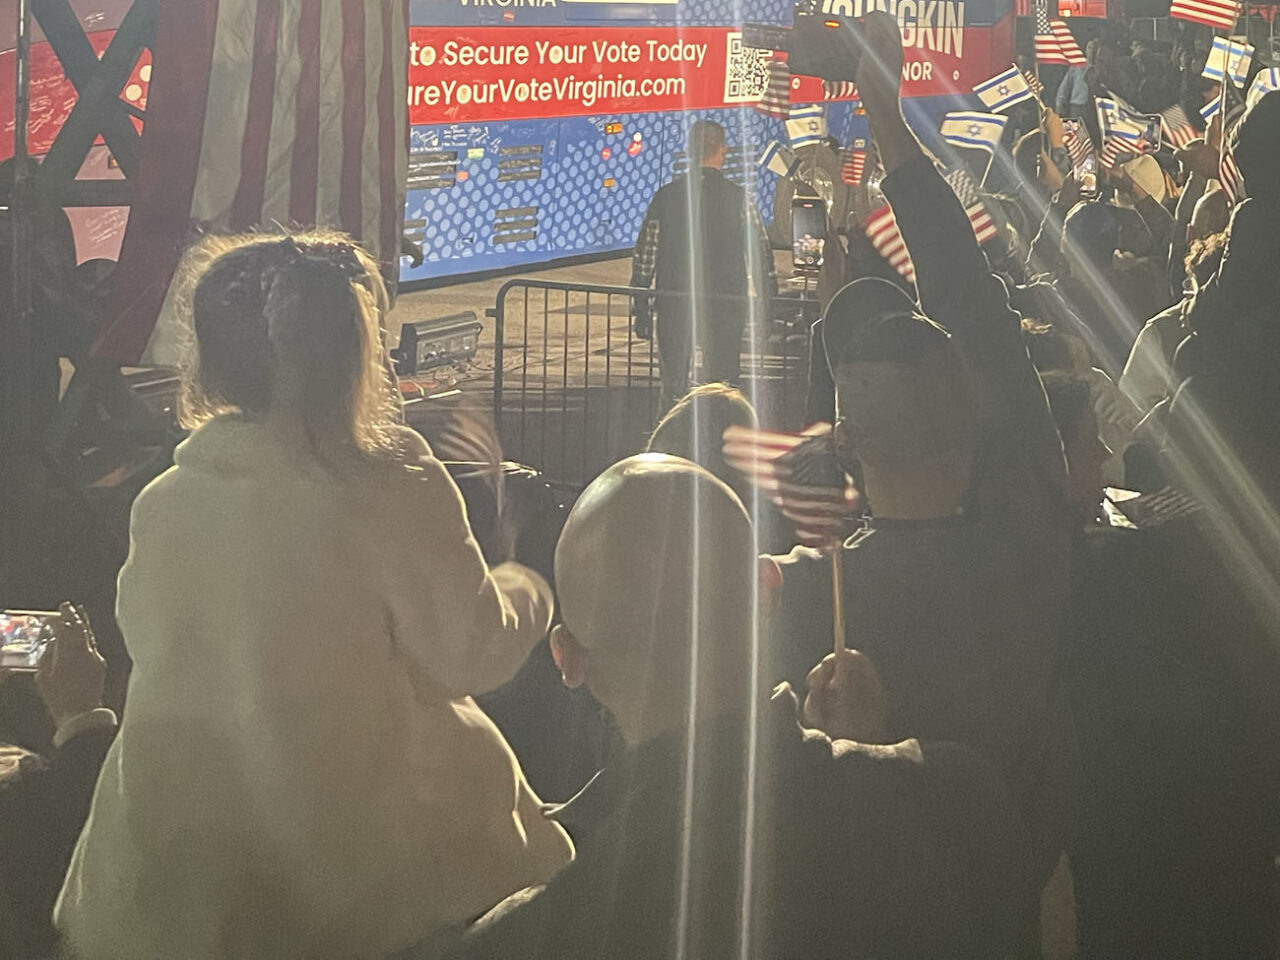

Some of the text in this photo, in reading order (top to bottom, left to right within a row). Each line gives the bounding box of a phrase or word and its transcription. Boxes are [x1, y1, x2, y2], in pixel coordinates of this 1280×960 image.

[409, 39, 707, 68] to Secure Your Vote Today
